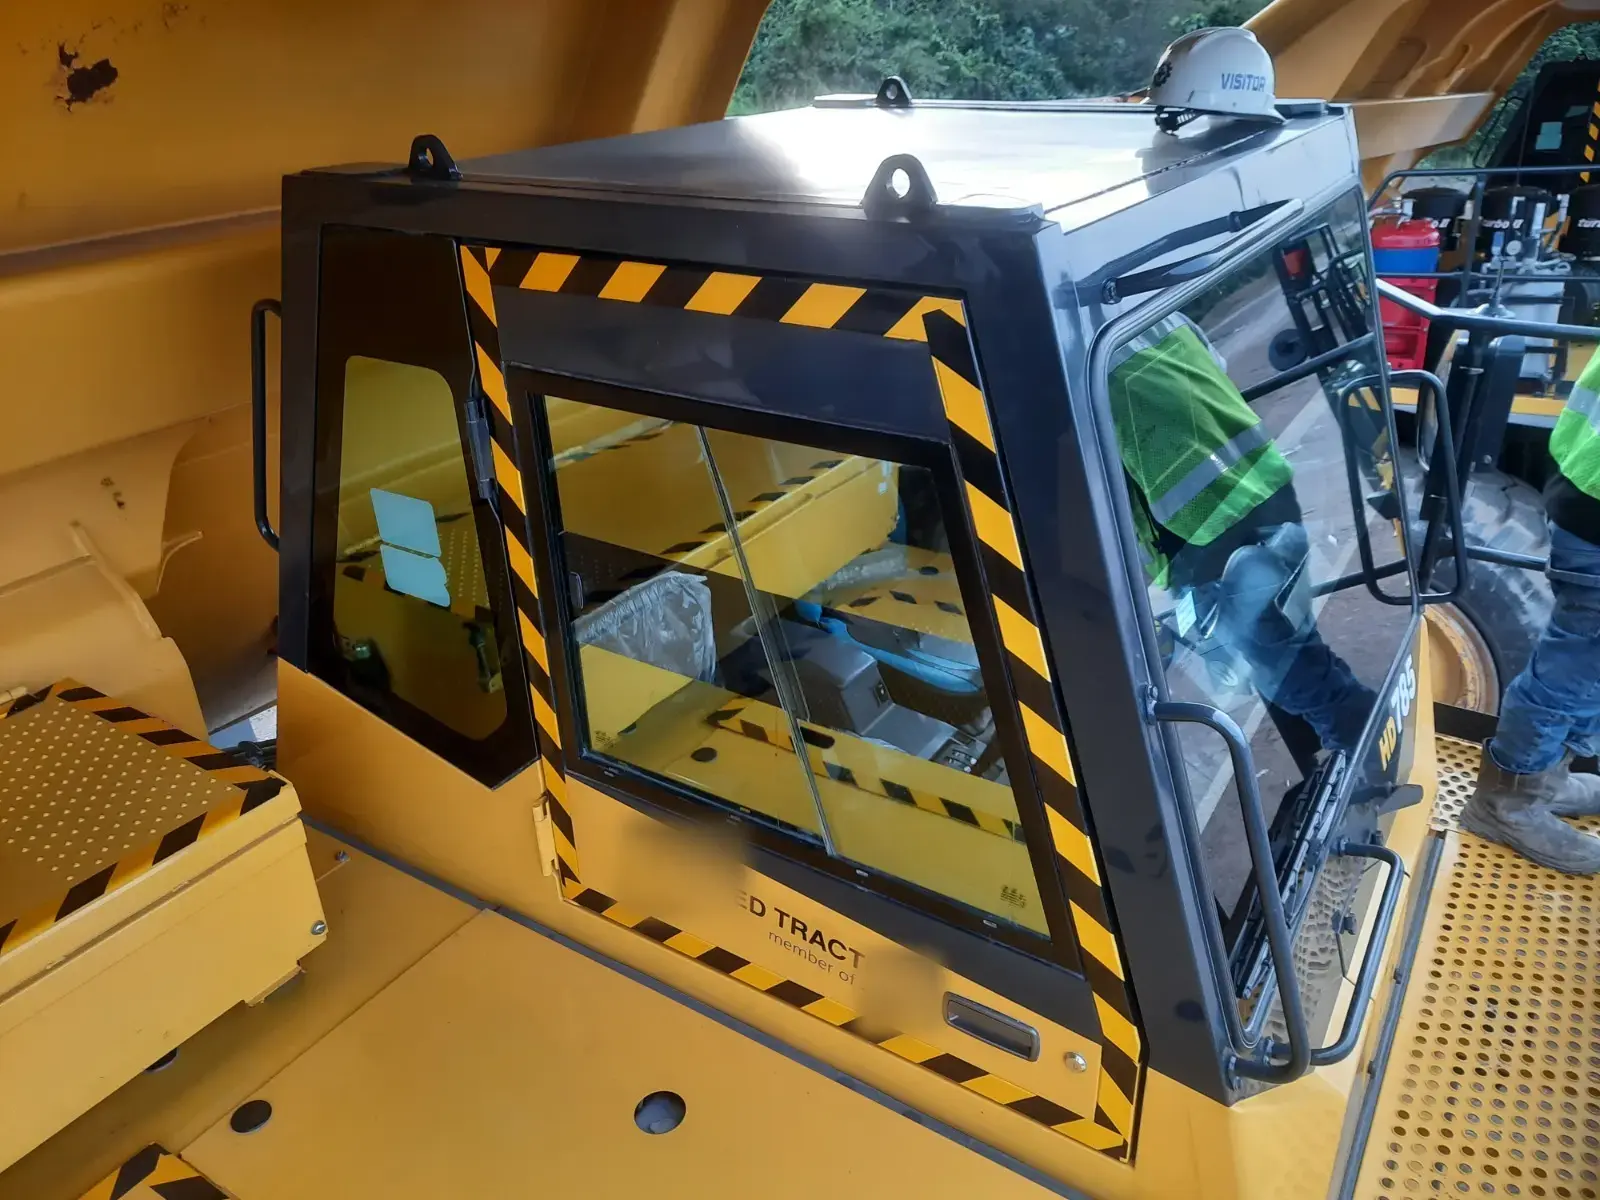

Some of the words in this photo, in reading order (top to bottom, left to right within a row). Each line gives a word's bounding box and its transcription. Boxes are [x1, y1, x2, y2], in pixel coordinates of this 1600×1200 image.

[1221, 72, 1266, 92] VISITOR
[1379, 715, 1397, 772] HD
[1391, 653, 1416, 734] 785
[768, 931, 833, 973] member
[838, 969, 856, 985] of
